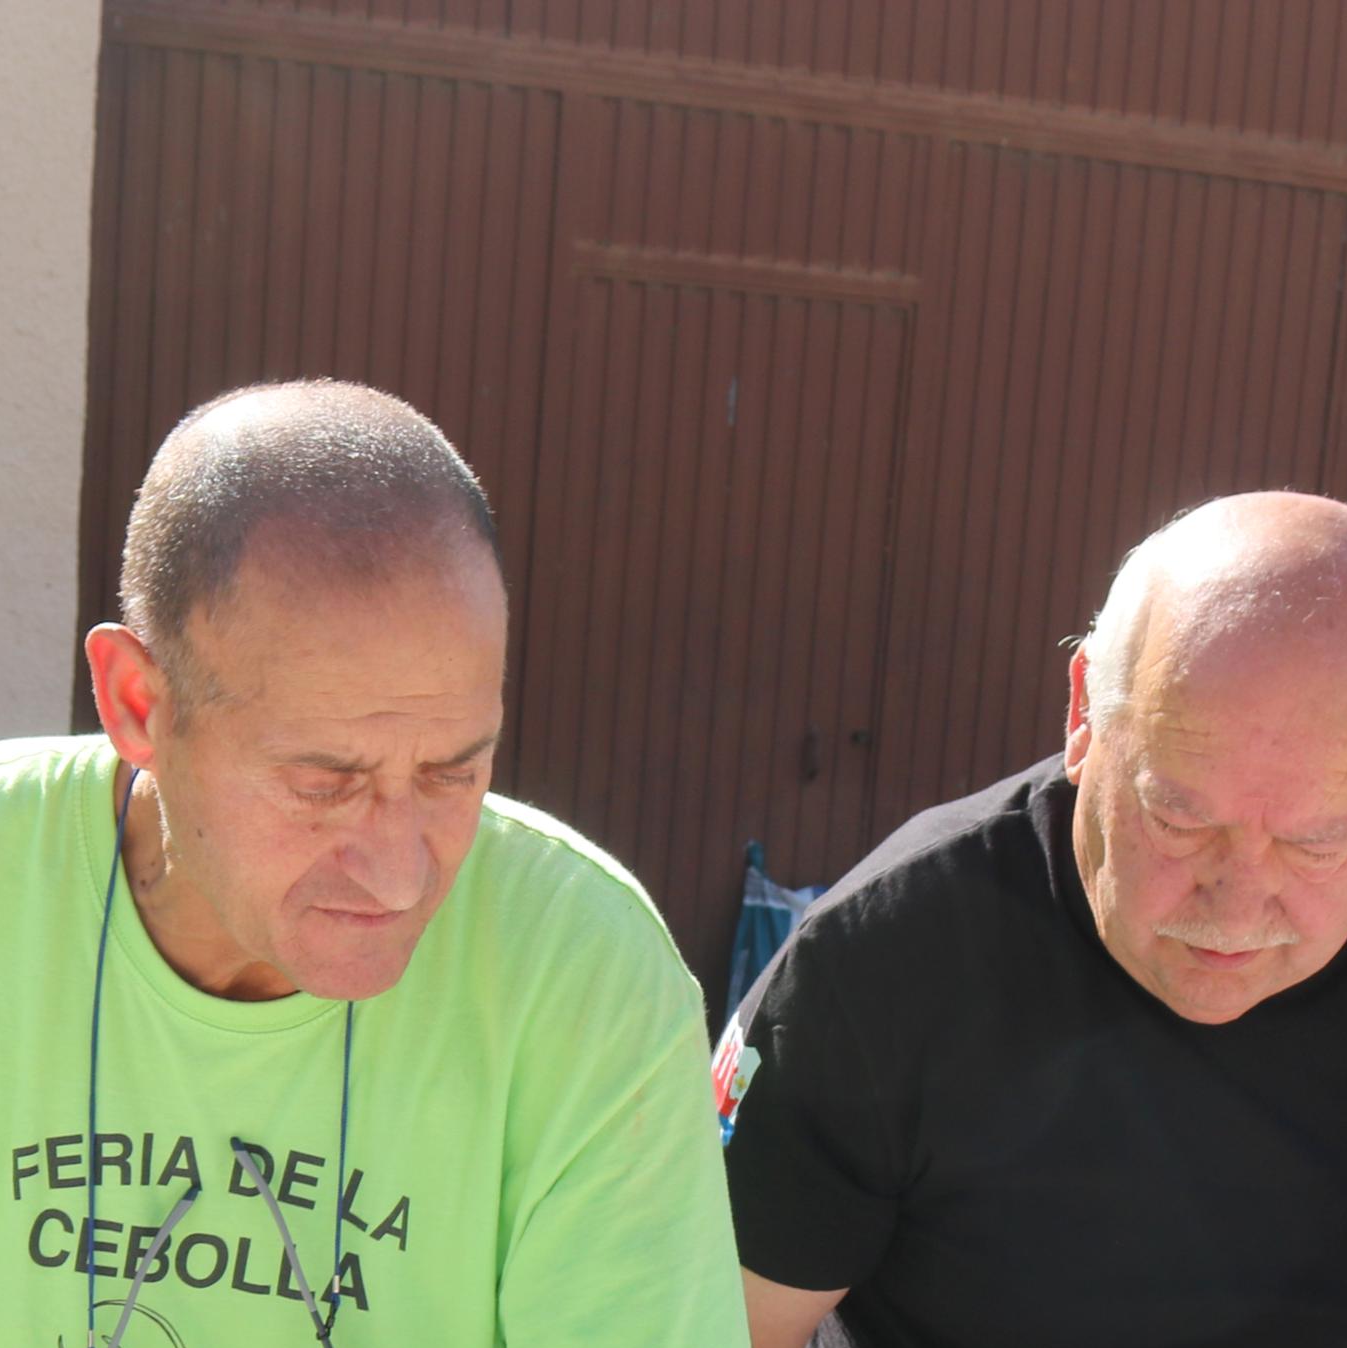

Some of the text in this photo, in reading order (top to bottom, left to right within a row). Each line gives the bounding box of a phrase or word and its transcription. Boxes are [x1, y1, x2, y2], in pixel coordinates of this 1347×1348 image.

[11, 1132, 410, 1251] FERIA DE LA
[28, 1209, 370, 1311] CEBOLLA
